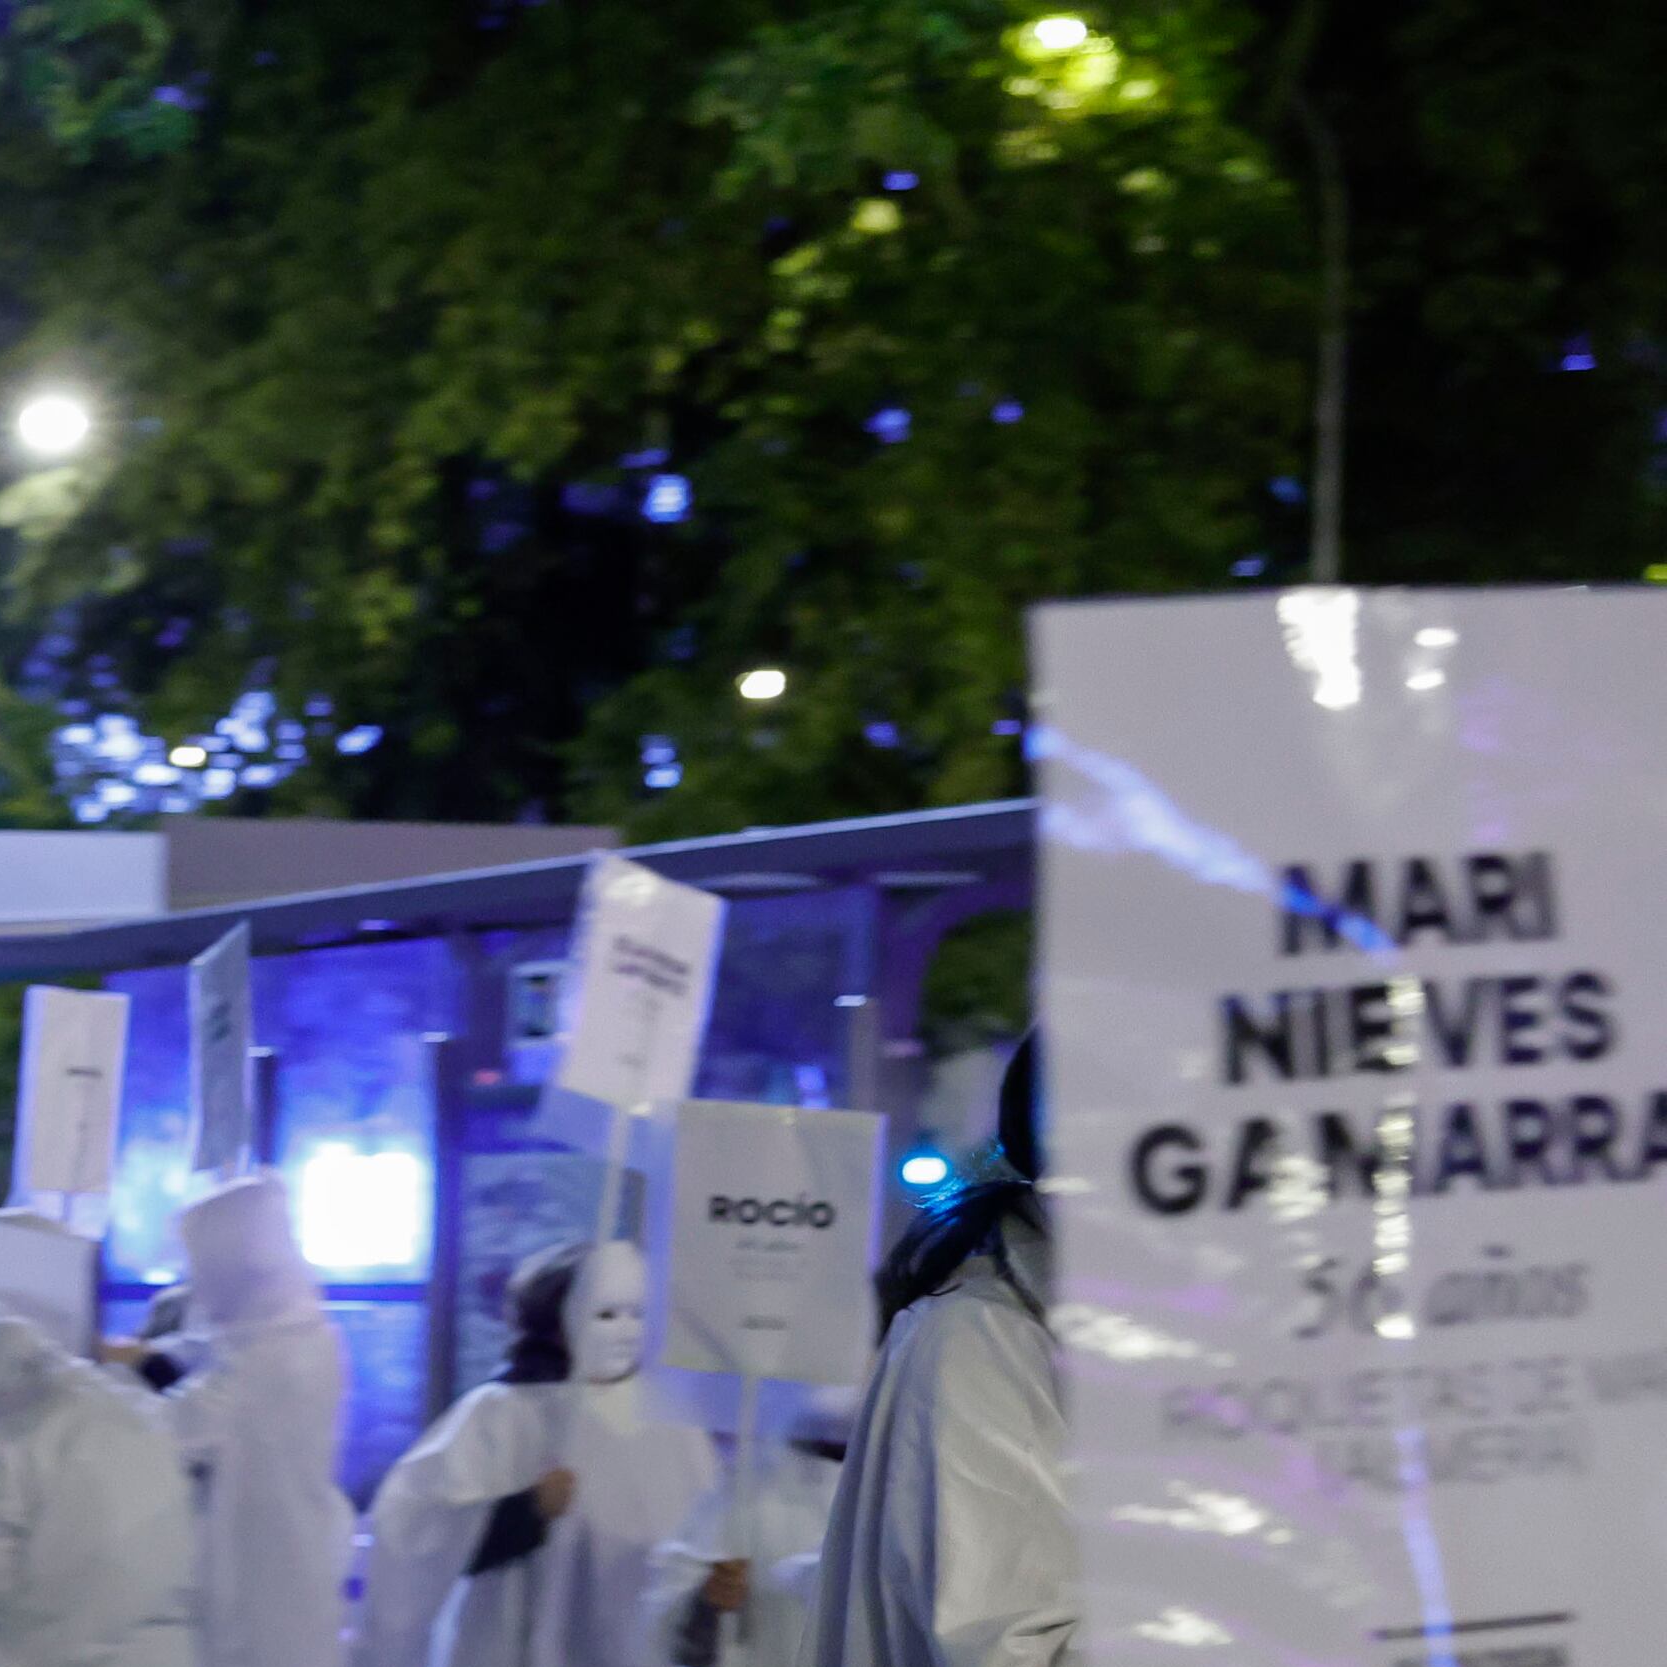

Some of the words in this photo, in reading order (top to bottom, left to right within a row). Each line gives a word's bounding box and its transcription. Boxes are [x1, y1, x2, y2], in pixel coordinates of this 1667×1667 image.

[1280, 851, 1558, 956] MARI
[1218, 971, 1615, 1085] NIEVES
[709, 1193, 836, 1229] ROCÍO
[1422, 1245, 1590, 1328] años
